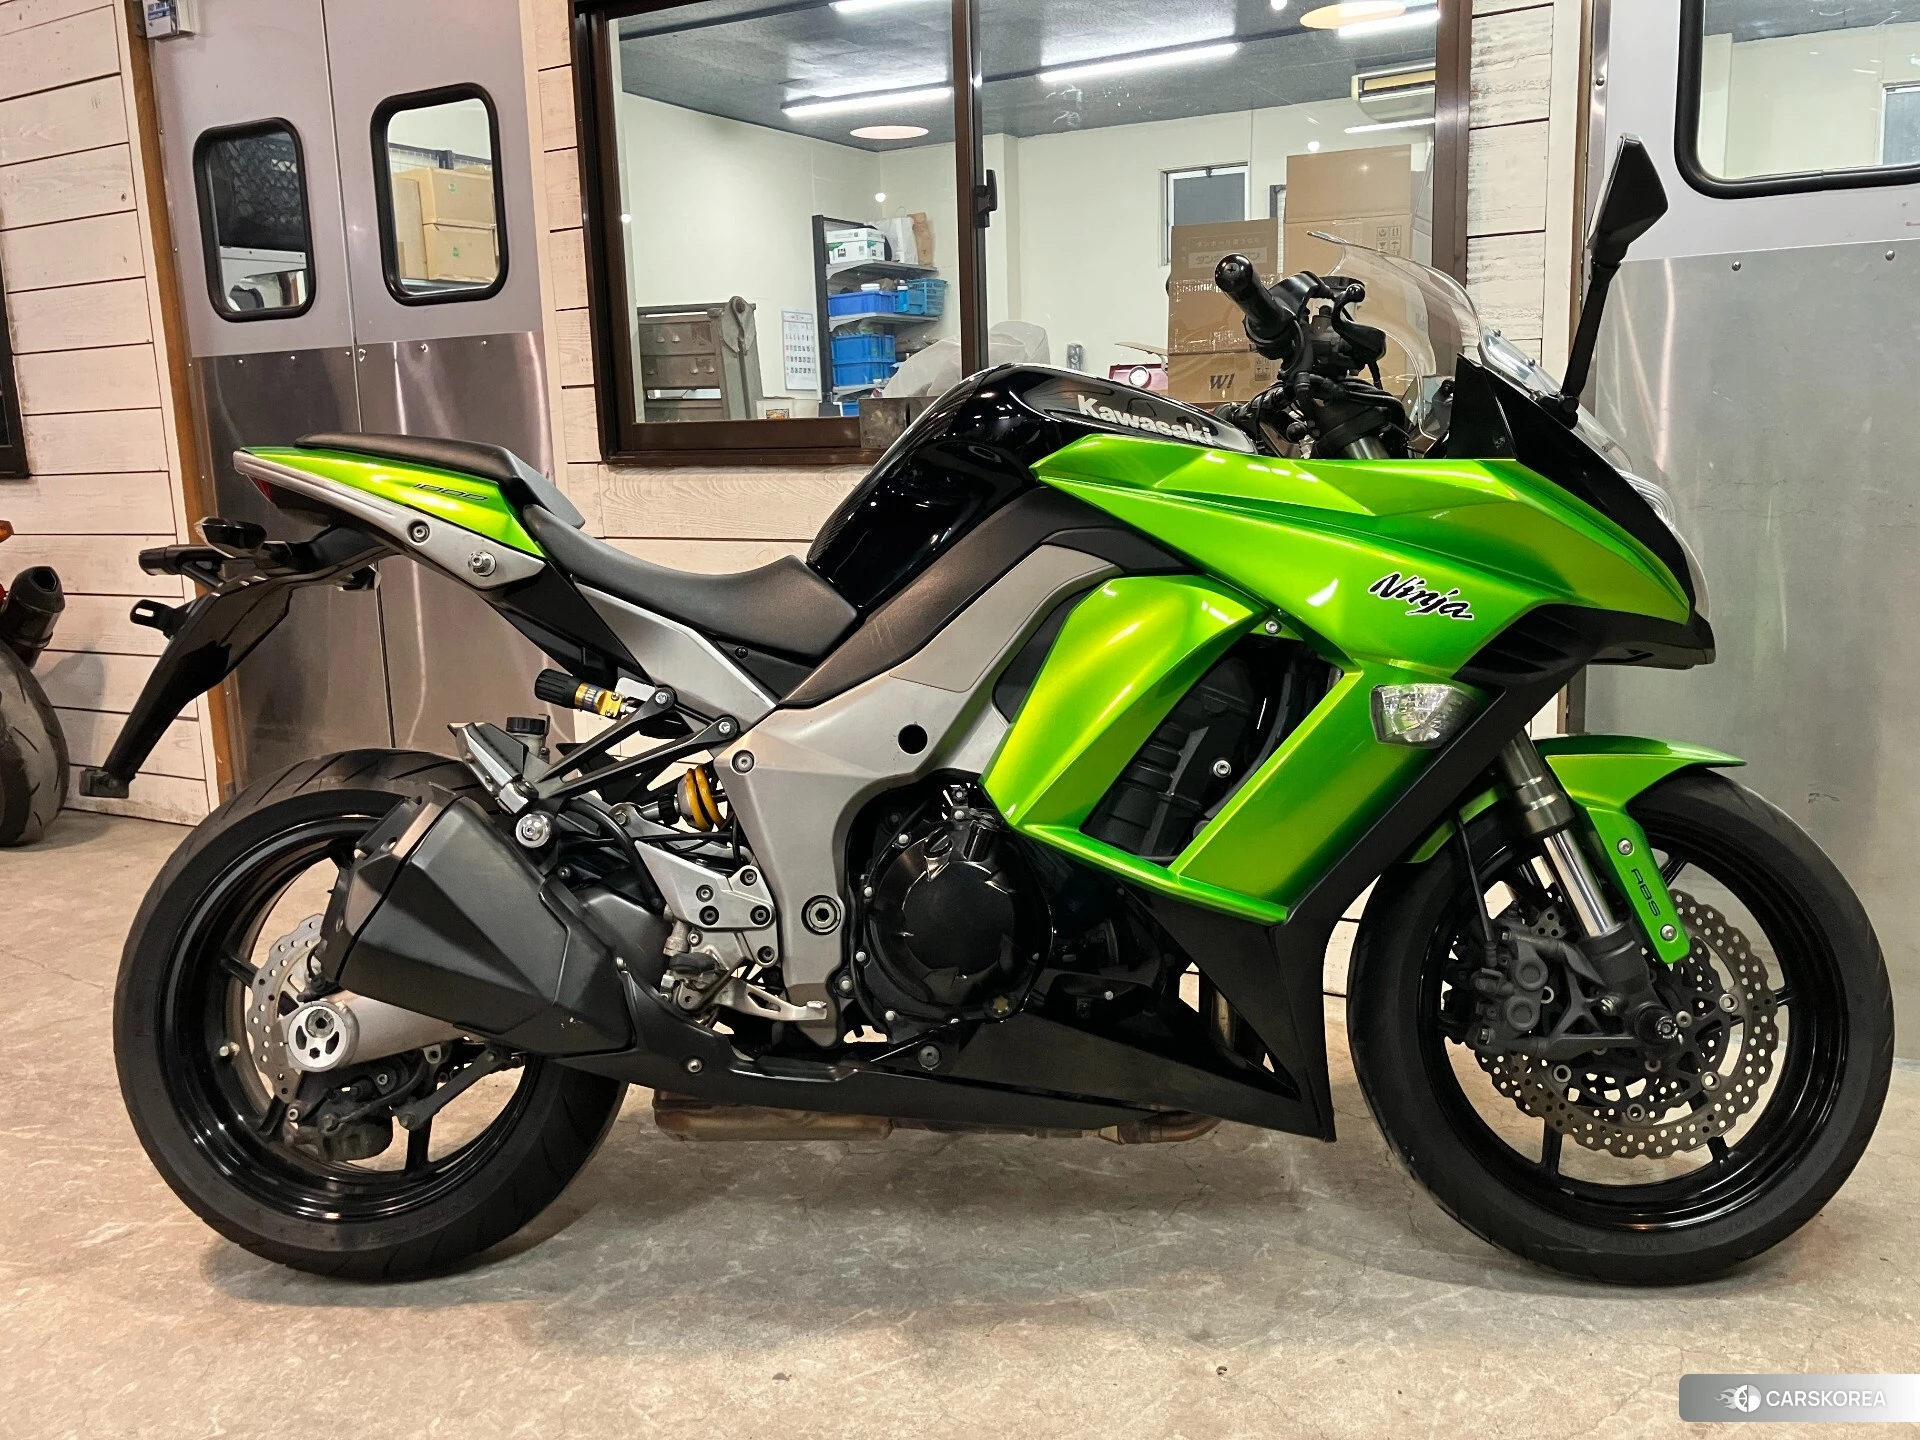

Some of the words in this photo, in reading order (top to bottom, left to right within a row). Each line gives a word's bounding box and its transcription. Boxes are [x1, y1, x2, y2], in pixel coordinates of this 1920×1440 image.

[1077, 394, 1214, 445] Kawasaki
[413, 483, 488, 501] 1000
[1368, 572, 1474, 620] Ninja
[1631, 868, 1660, 917] ABS
